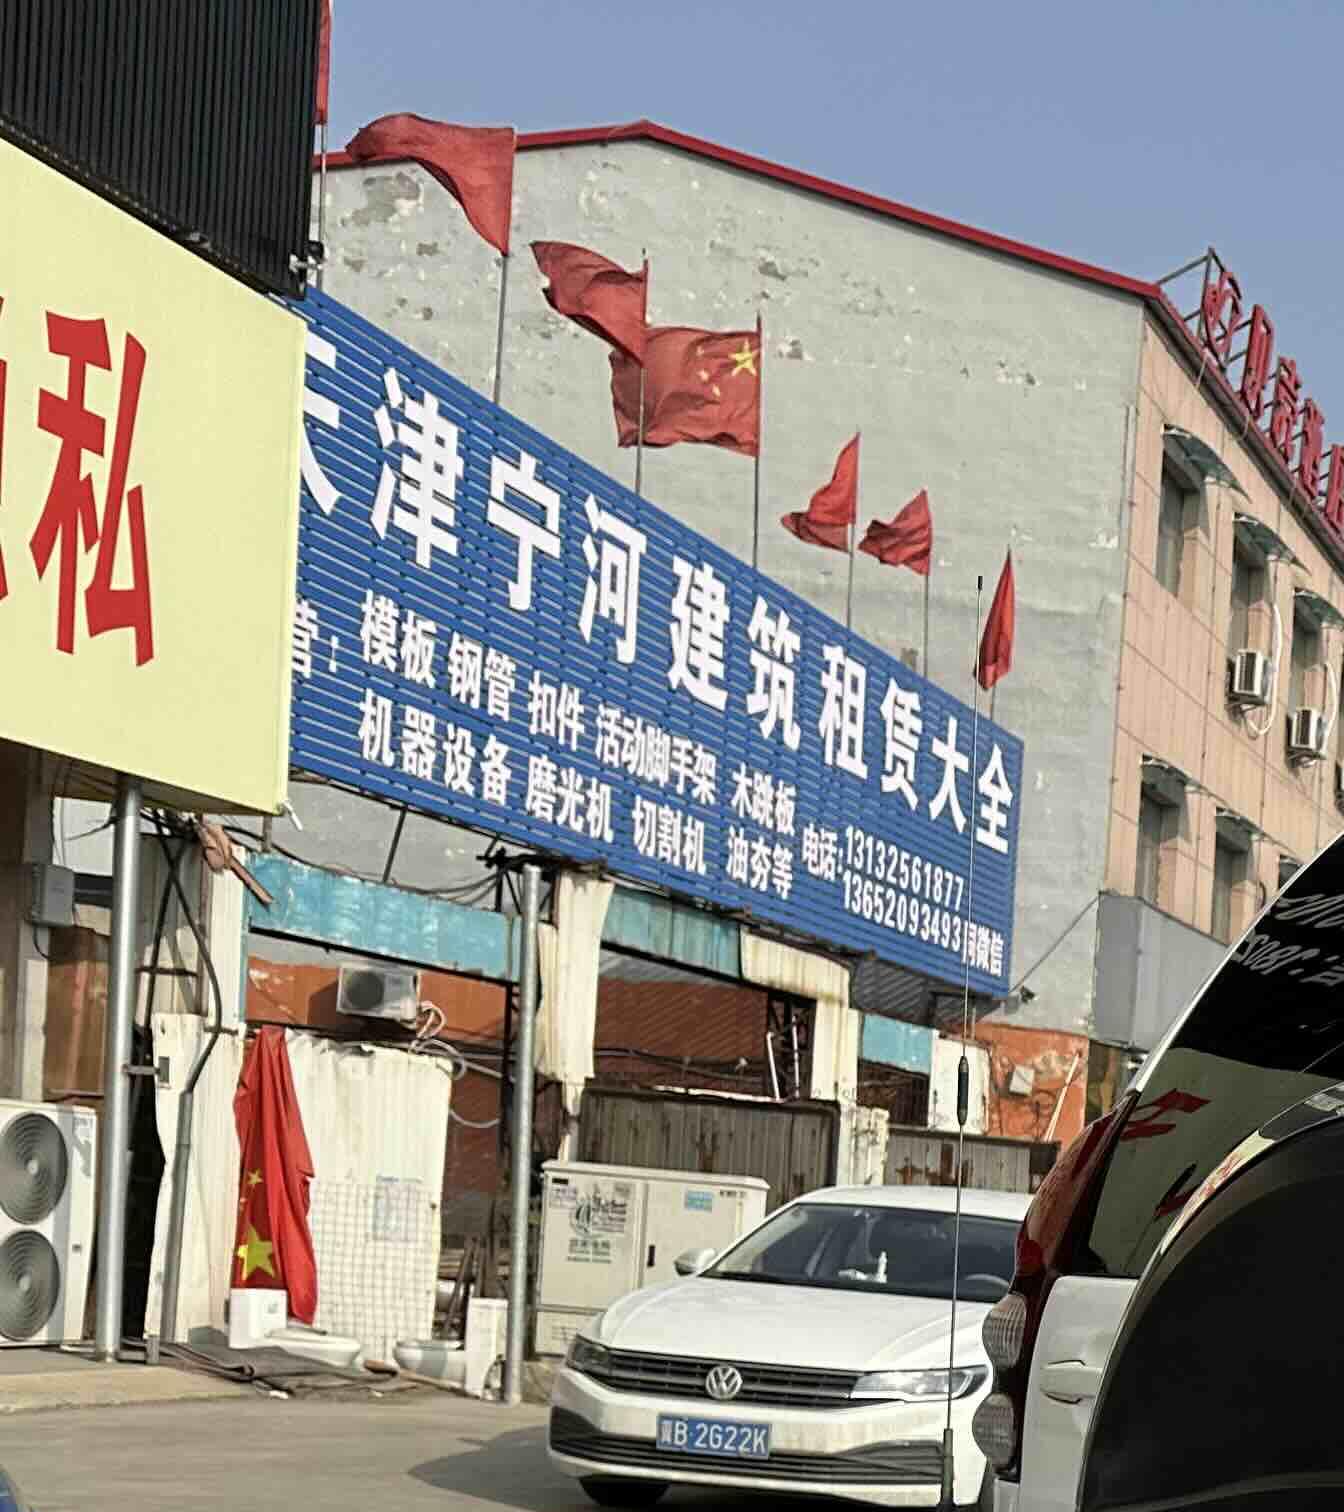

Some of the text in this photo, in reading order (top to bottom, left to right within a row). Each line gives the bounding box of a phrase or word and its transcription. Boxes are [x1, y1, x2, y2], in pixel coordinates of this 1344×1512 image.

[0, 297, 154, 667] 私
[358, 687, 512, 806] 机器设备
[524, 754, 614, 844] 磨光机
[631, 794, 707, 876] 切割机
[359, 588, 437, 689] 模板
[447, 630, 517, 722] 钢管
[527, 669, 585, 751] 扣件
[595, 703, 717, 805] 活动脚手架
[731, 761, 797, 837] 木跳板
